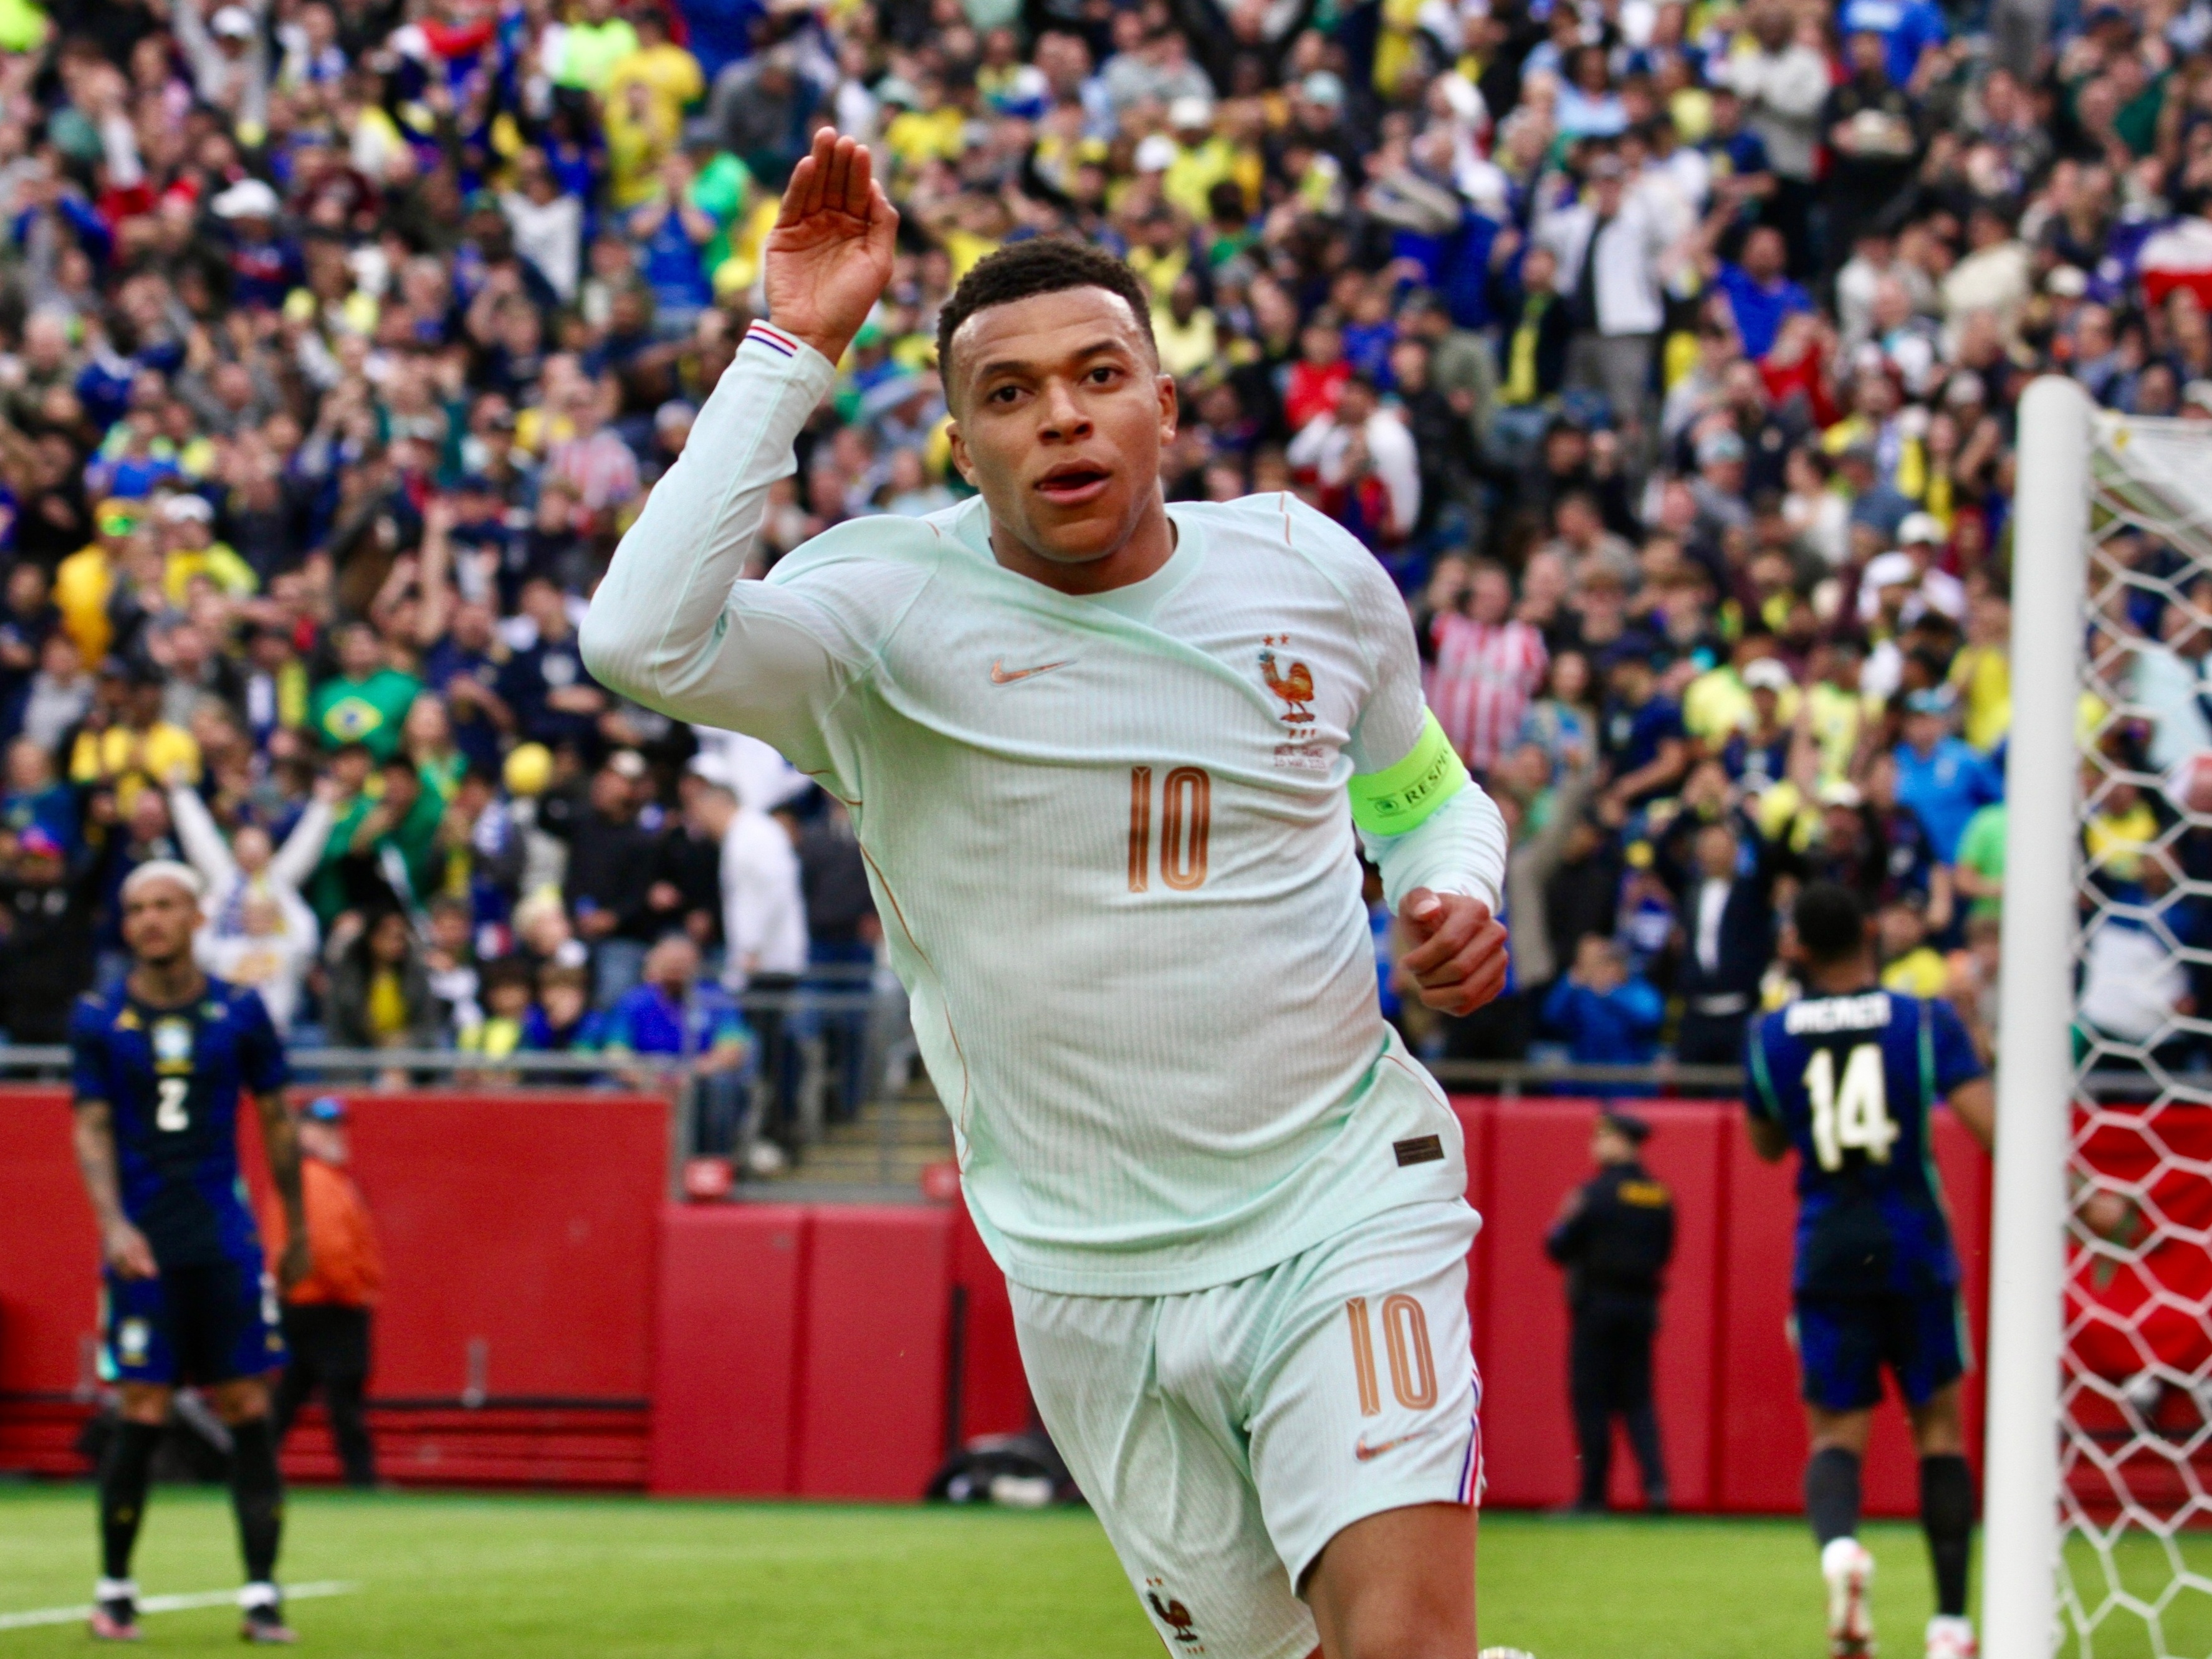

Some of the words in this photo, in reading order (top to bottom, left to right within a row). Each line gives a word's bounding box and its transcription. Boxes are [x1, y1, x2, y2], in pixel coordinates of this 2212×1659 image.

[1128, 767, 1210, 893] 10
[157, 1078, 189, 1132] 2
[1803, 1043, 1899, 1172] 14
[1346, 1293, 1438, 1417] 10
